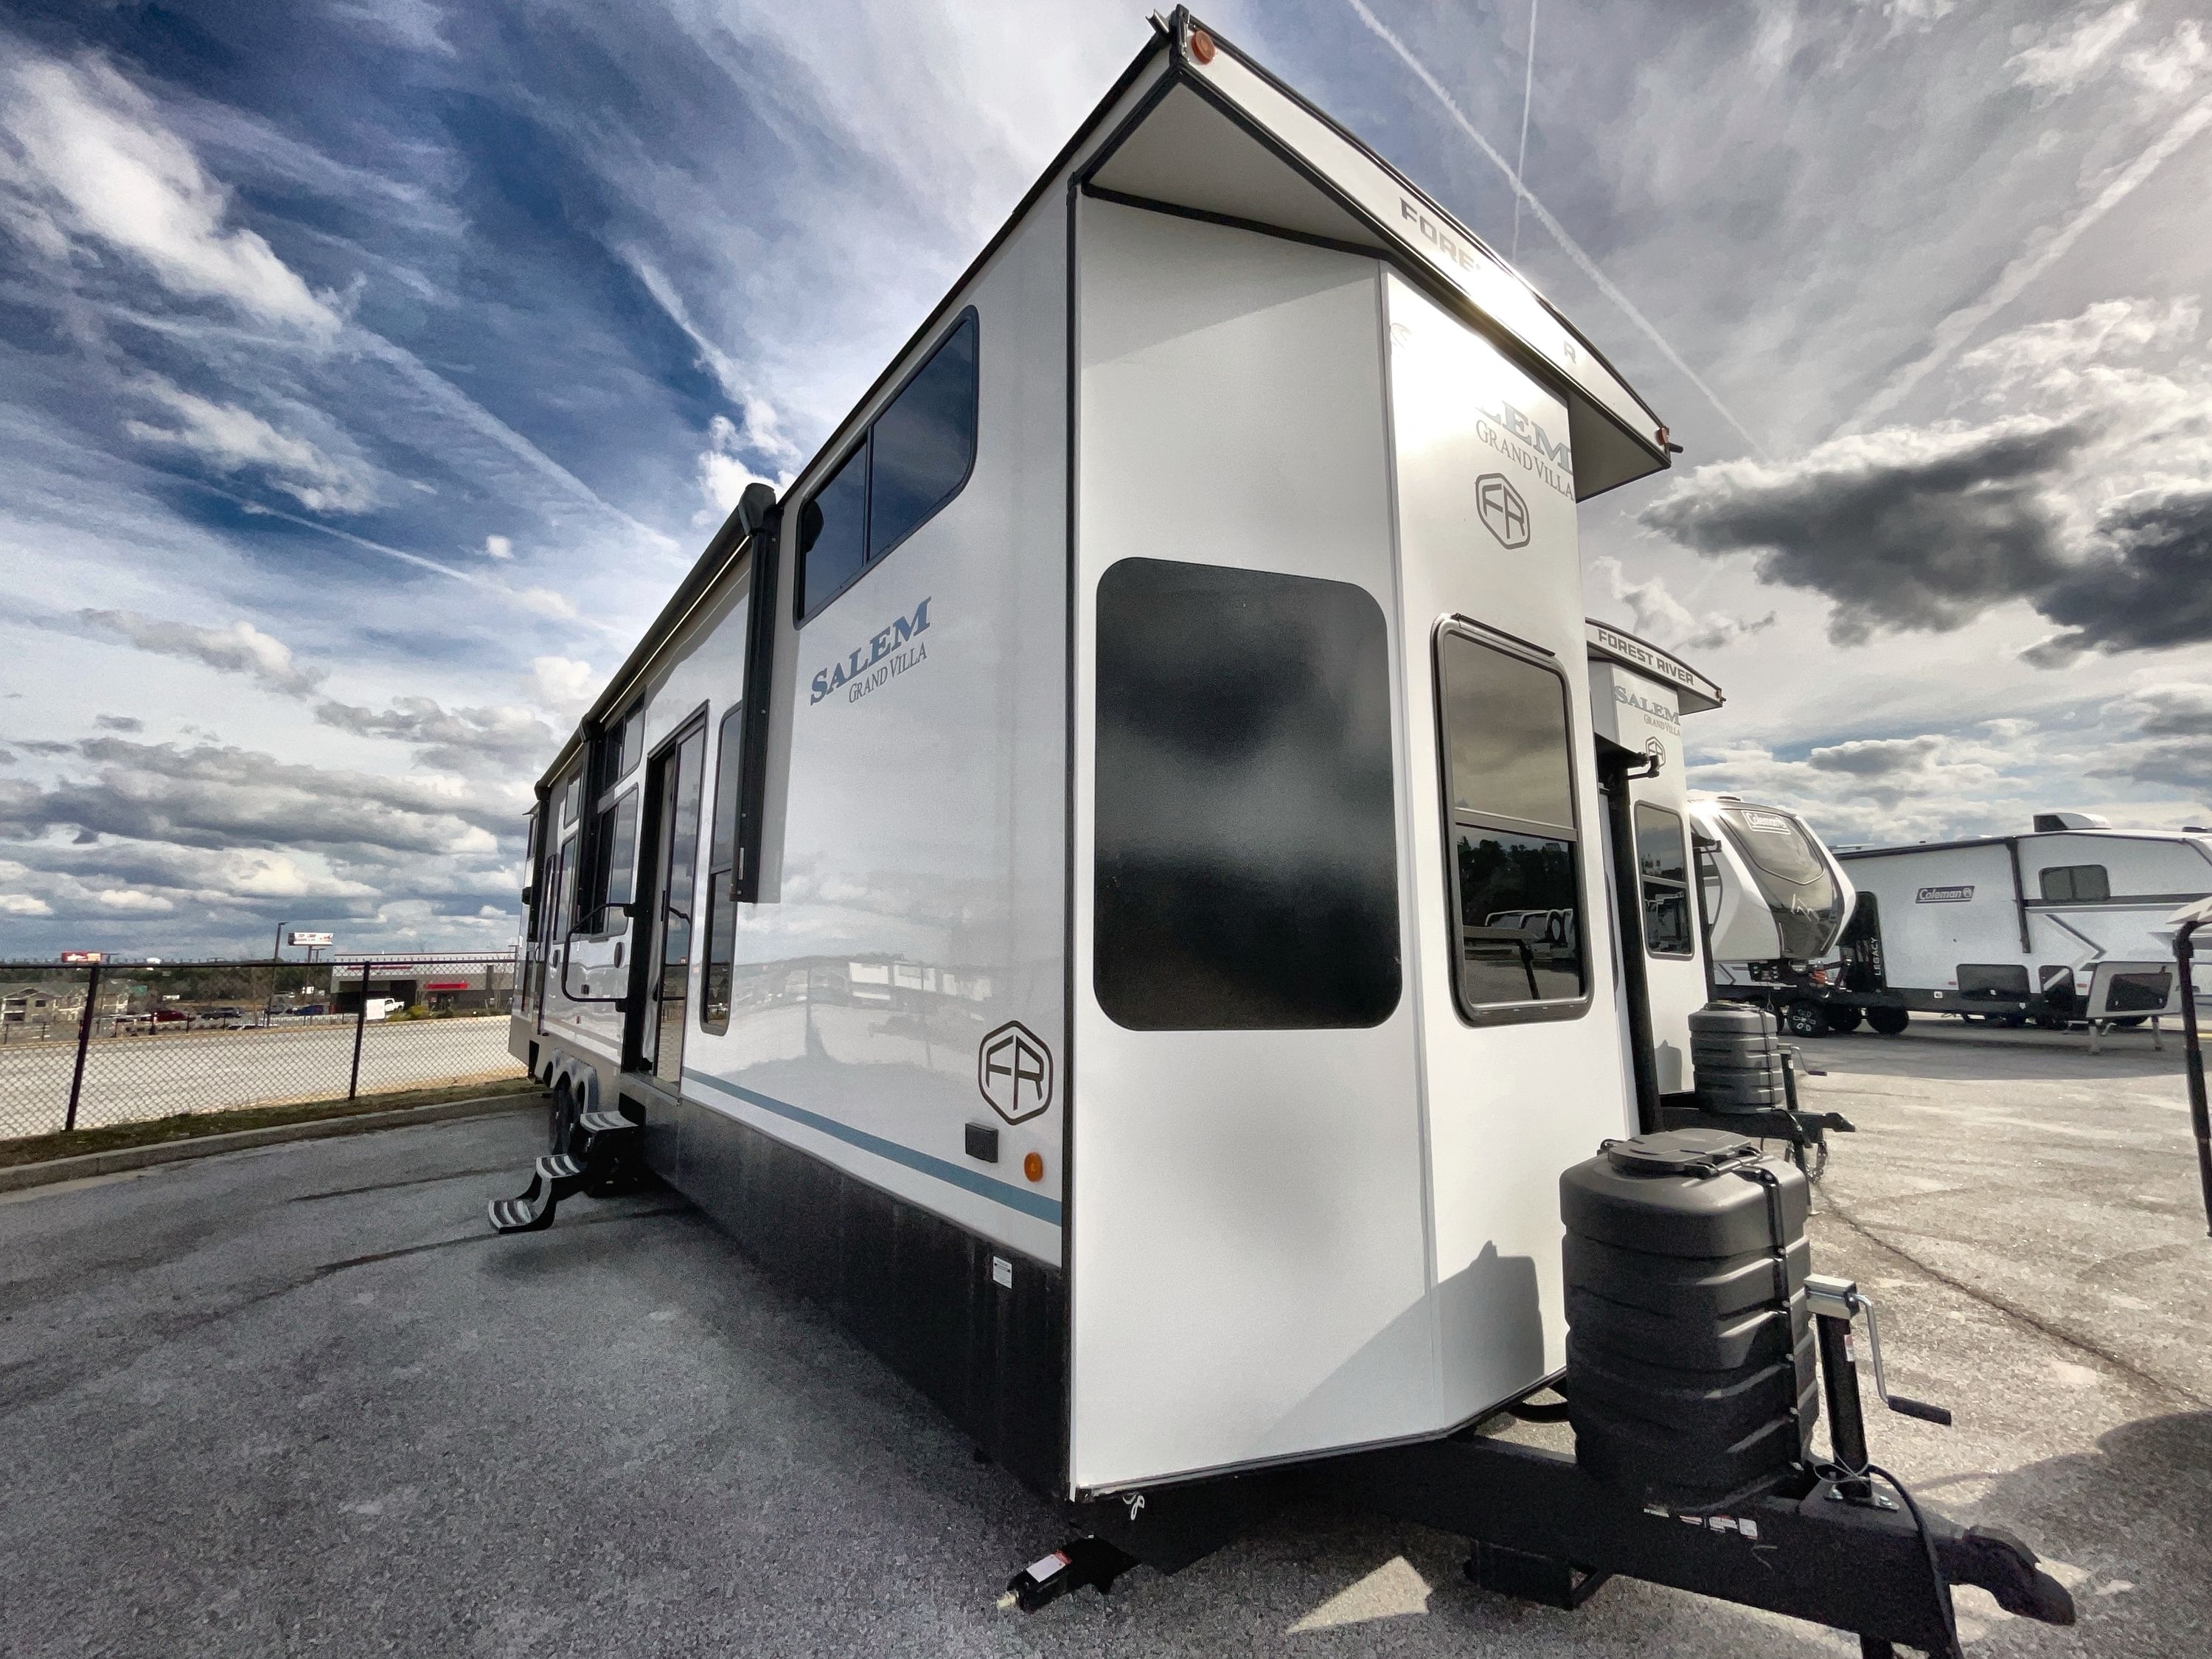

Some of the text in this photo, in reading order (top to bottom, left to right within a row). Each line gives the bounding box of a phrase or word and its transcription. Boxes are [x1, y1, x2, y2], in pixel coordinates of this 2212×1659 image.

[1475, 420, 1575, 502] GRAND VILLA
[810, 596, 932, 706] SALEM
[849, 641, 928, 703] GRAND VILLA
[1598, 629, 1694, 686] FOREST RIVER
[1614, 685, 1680, 726] SALEM
[1644, 714, 1681, 737] GRAND VILLA
[1919, 888, 1961, 900] Coleman
[1871, 936, 1881, 975] LEGACY
